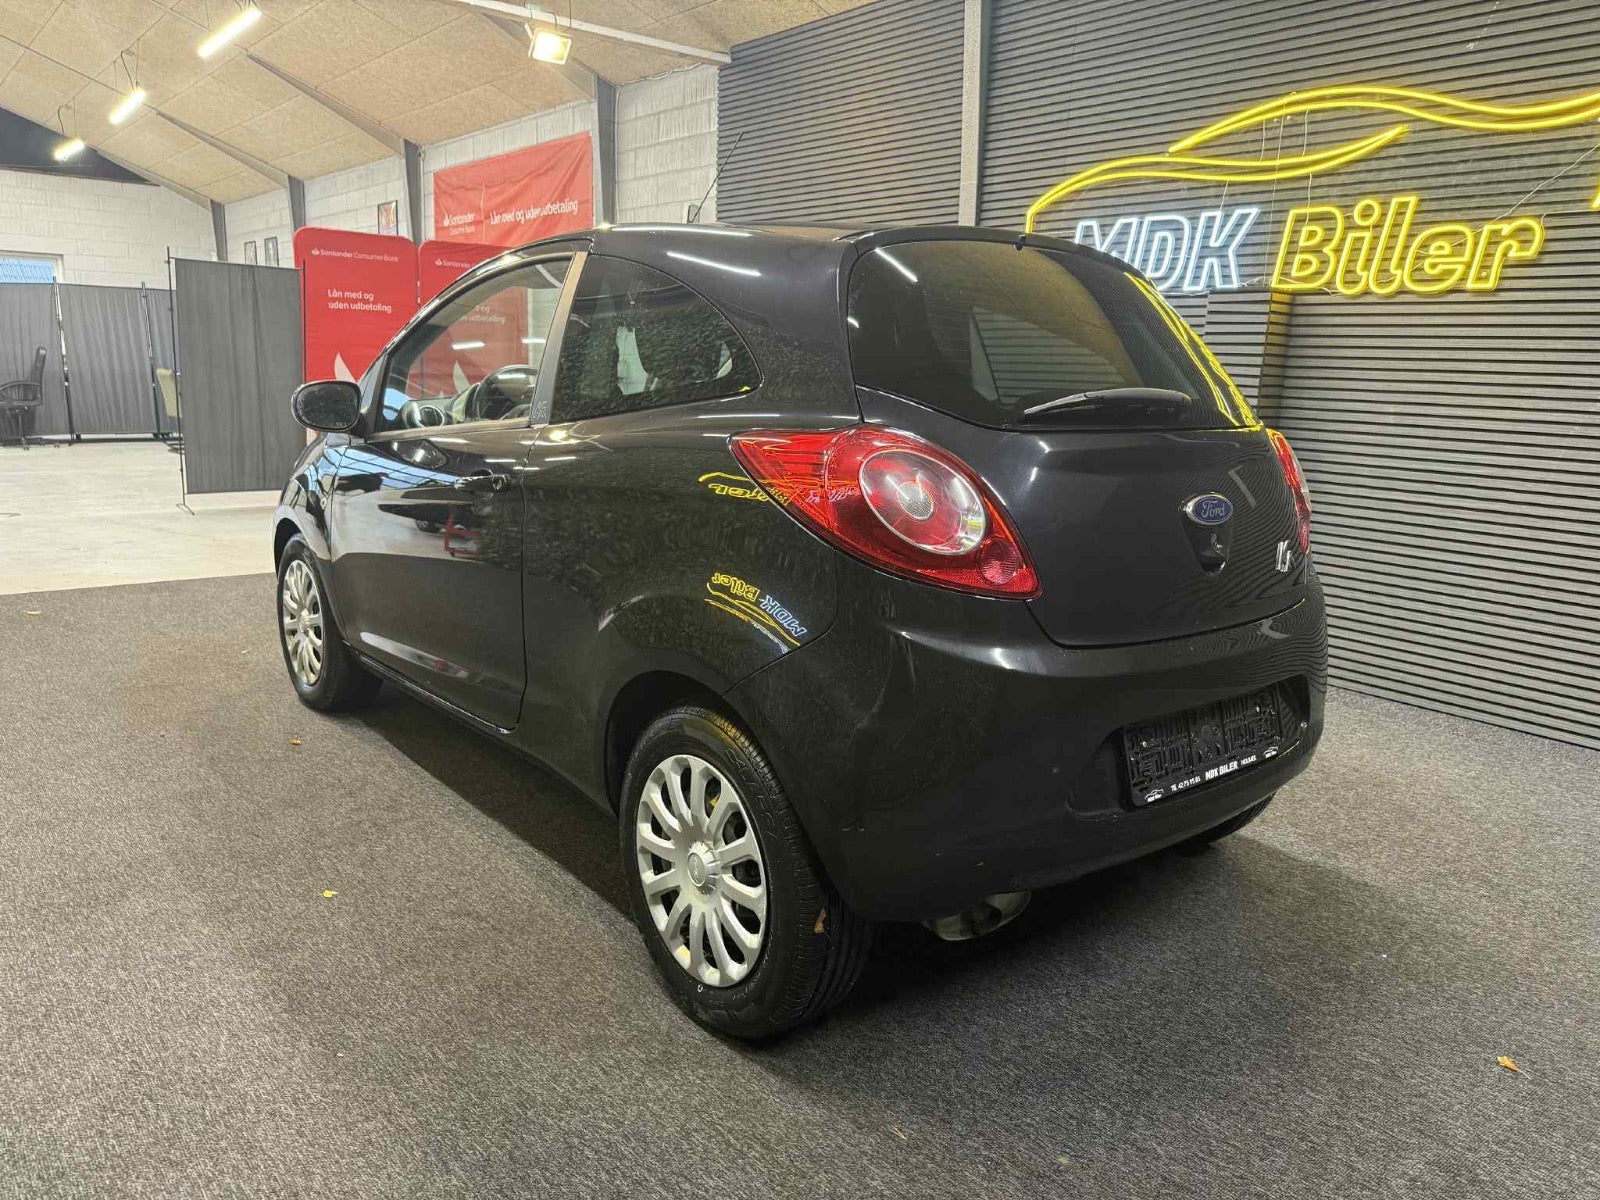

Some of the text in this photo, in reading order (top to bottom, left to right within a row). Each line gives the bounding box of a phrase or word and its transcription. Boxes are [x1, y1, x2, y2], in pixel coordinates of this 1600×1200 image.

[515, 209, 525, 225] og
[1074, 195, 1545, 295] MDK Biler
[320, 249, 353, 258] Santander
[328, 288, 374, 301] Lån med og
[328, 301, 392, 313] uden udbetaling
[1201, 500, 1225, 518] Ford
[1219, 760, 1239, 775] BILER
